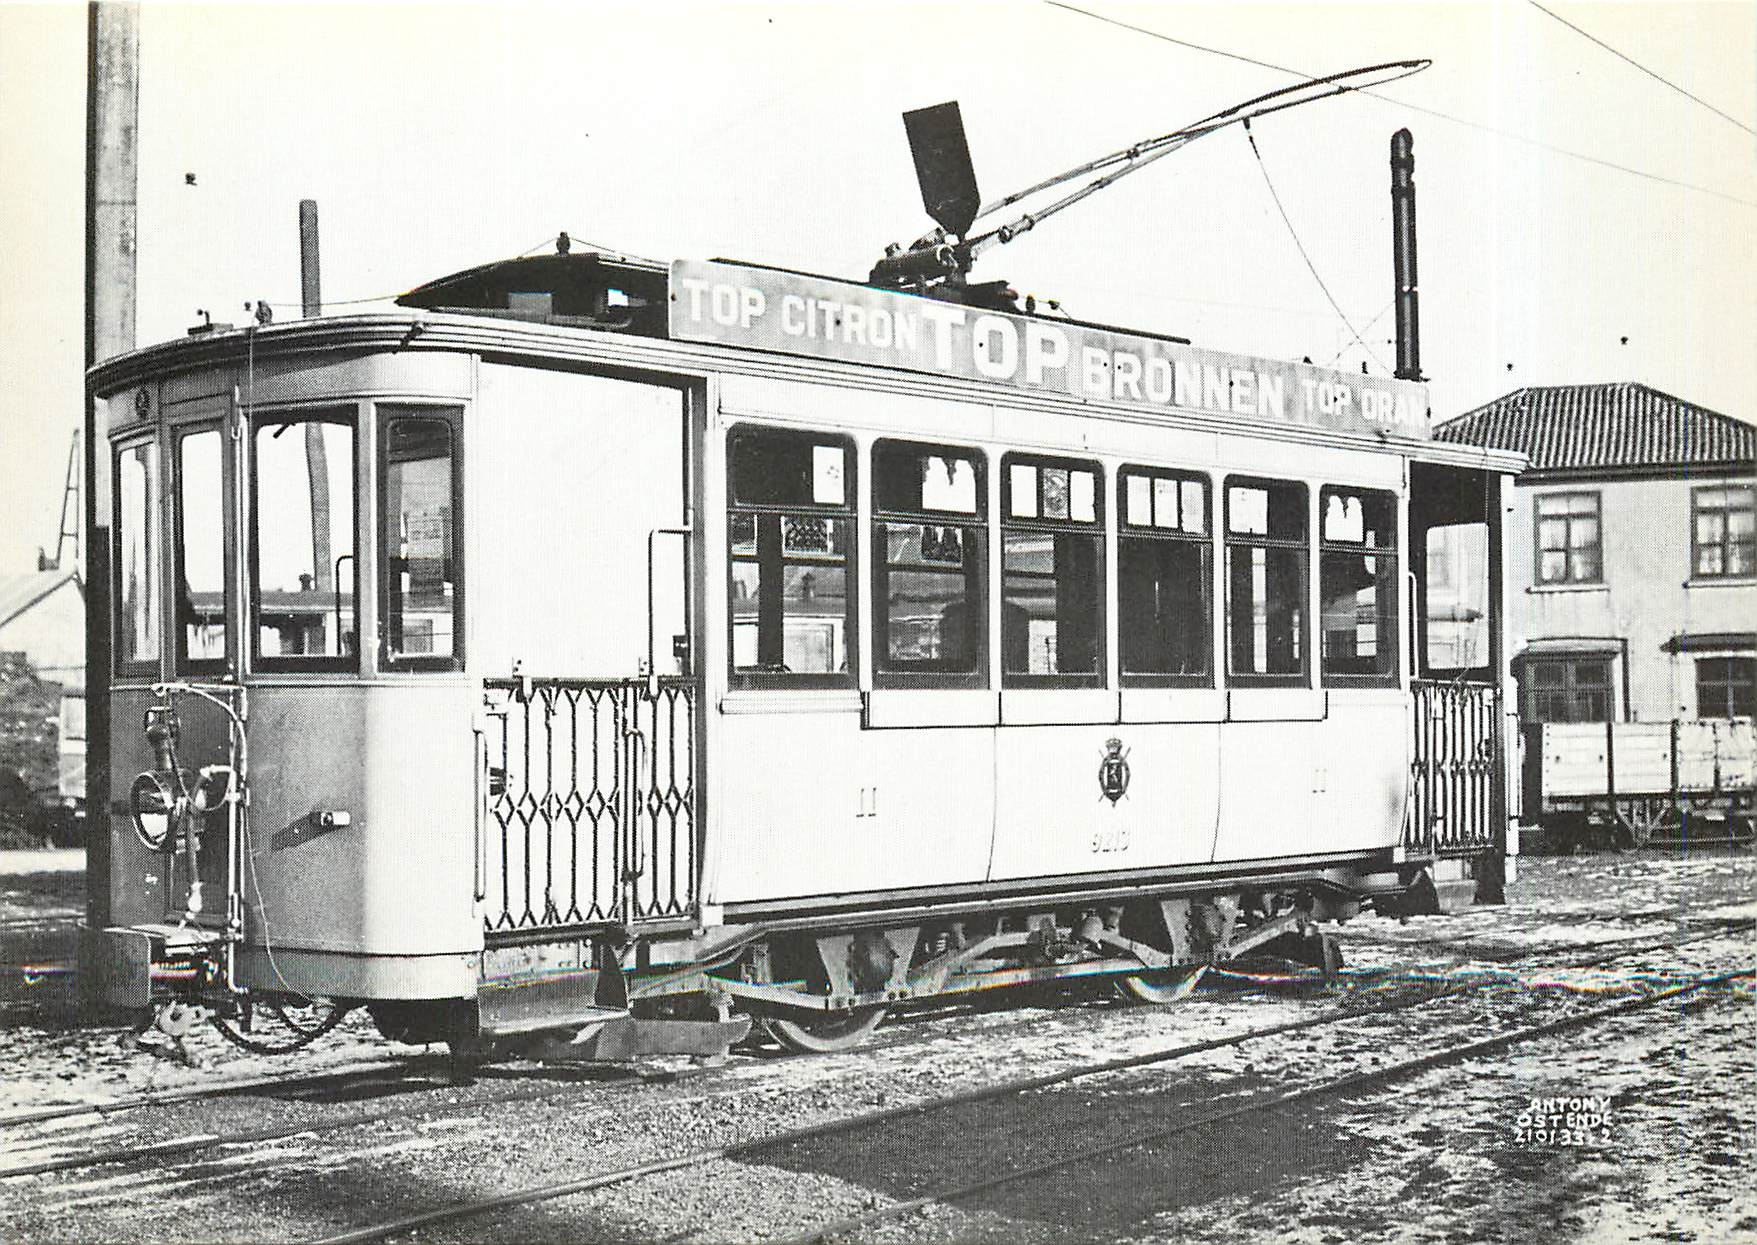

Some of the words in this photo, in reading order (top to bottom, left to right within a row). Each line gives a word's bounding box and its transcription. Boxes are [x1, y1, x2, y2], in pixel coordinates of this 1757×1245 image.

[682, 277, 767, 329] TOP
[780, 294, 922, 350] CITRON
[920, 304, 1070, 385] TOP
[1082, 346, 1284, 420] BRONNEN
[1302, 378, 1352, 416] TOP
